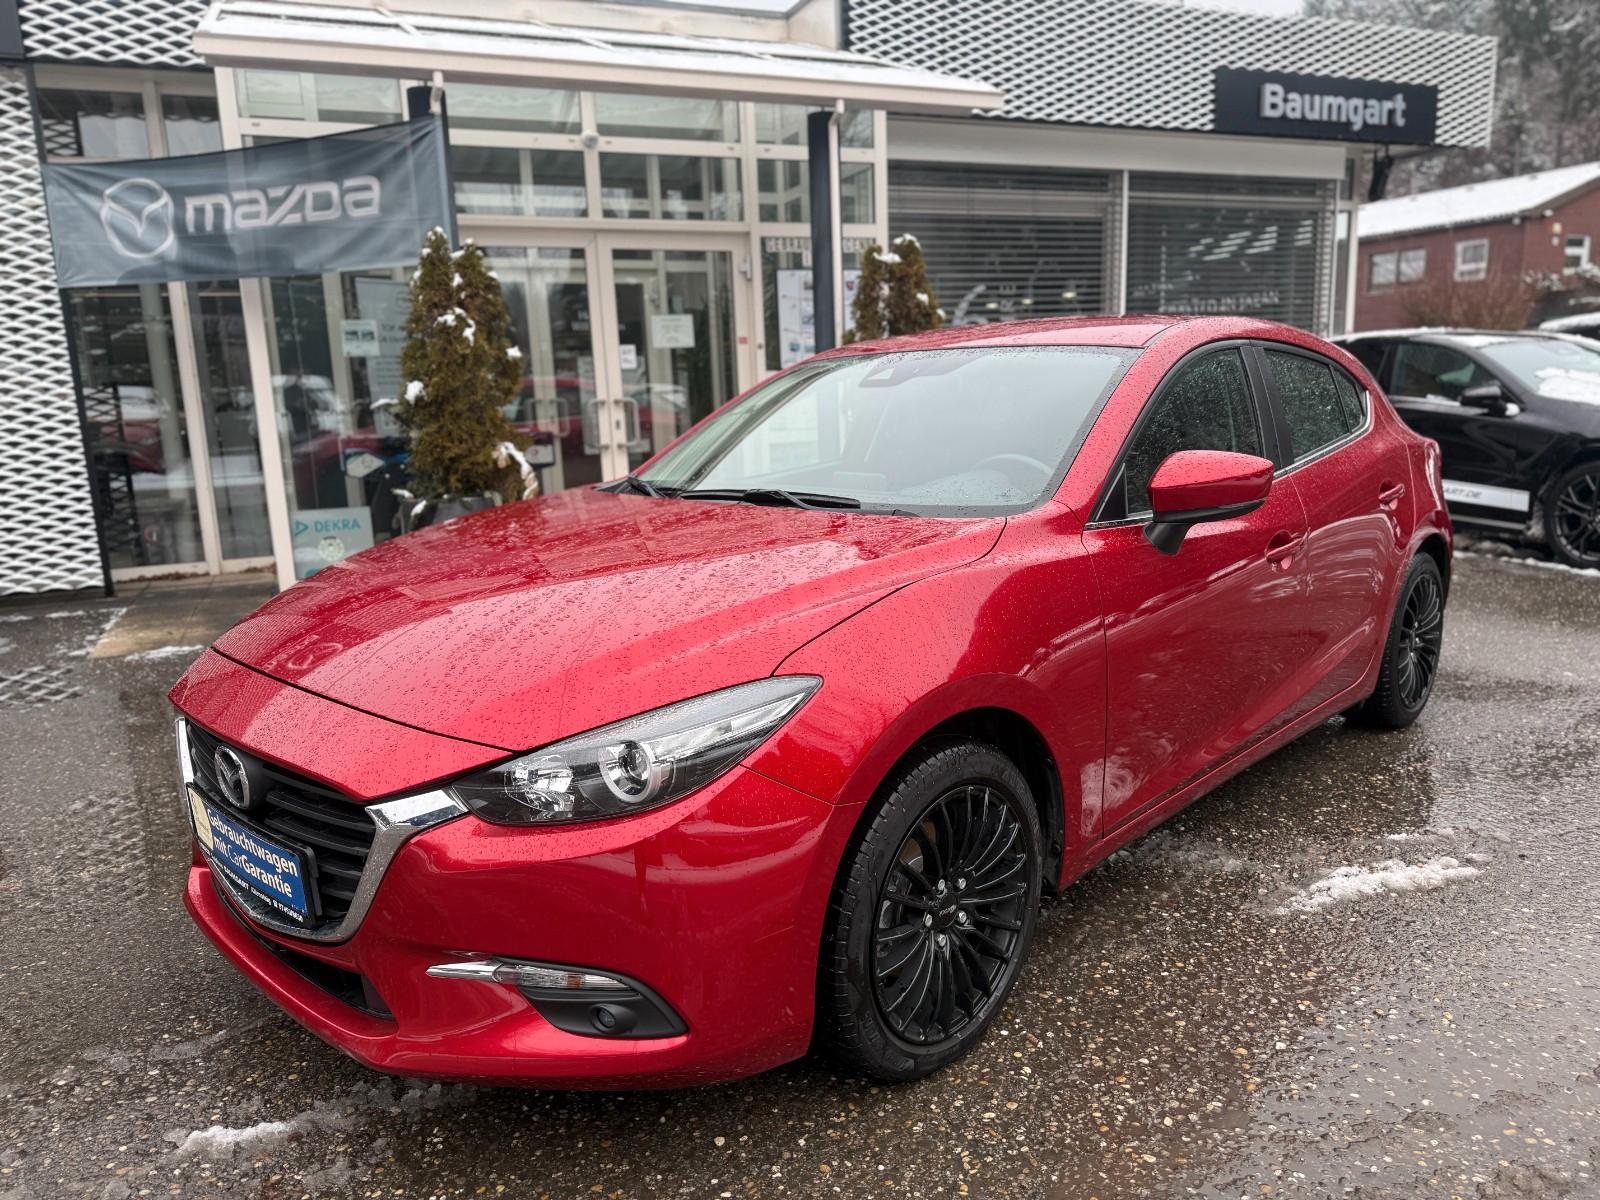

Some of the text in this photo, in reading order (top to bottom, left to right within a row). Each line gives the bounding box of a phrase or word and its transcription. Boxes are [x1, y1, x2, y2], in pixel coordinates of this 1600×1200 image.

[1261, 82, 1407, 132] Baumgart
[184, 175, 381, 233] mazda
[314, 518, 361, 533] DEKRA
[206, 809, 298, 877] Gebrauchtwagen
[213, 836, 228, 858] mit
[227, 844, 292, 898] CarGarantie
